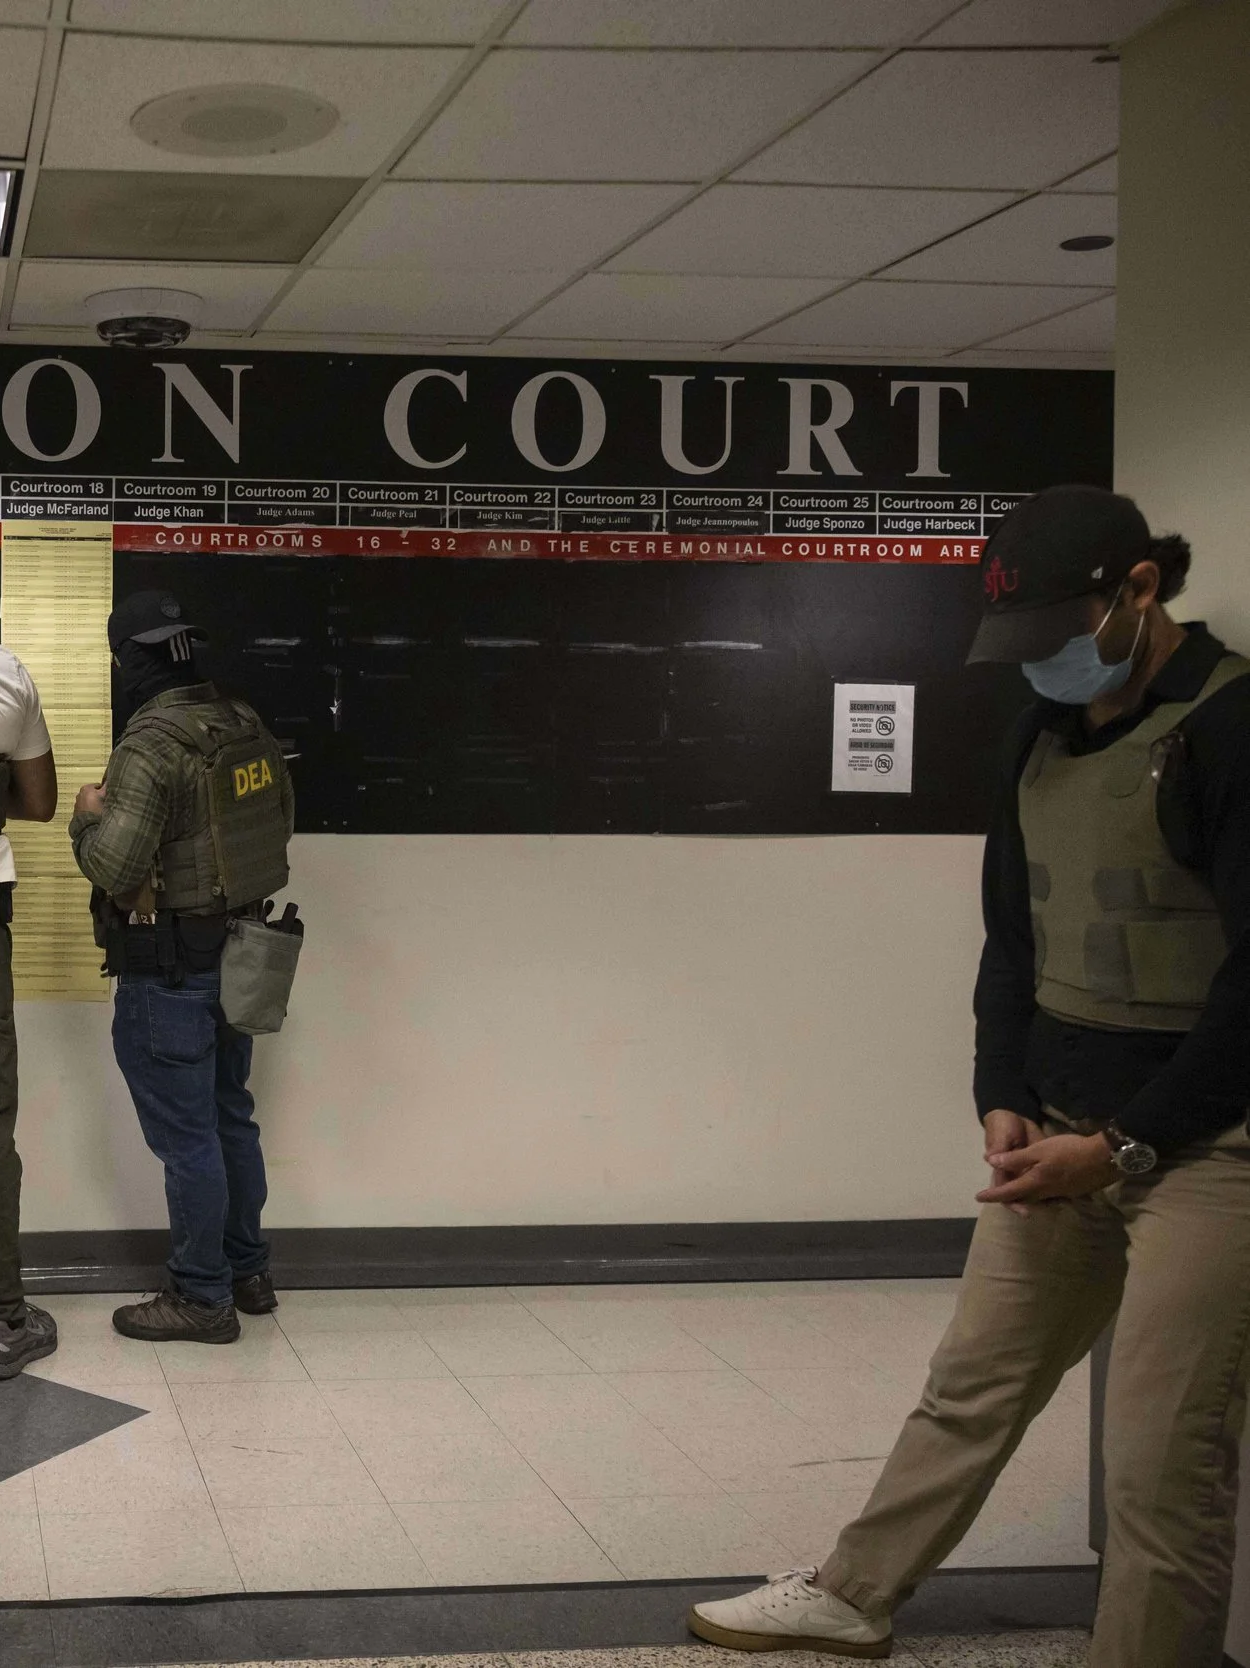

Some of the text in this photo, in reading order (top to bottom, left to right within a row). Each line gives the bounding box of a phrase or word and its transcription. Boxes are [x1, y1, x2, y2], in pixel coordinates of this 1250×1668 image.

[383, 368, 969, 477] COURT
[10, 481, 104, 496] Courtroom 18
[124, 483, 216, 496] Courtroom 19
[235, 485, 329, 498] Courtroom 20
[348, 488, 438, 500] Courtroom 21
[454, 490, 551, 503] Courtroom 22
[566, 493, 656, 505] Courtroom 23
[673, 494, 763, 506] Courtroom 24
[780, 496, 869, 508] Courtroom 25
[7, 503, 108, 516] Judge McFarland
[883, 497, 954, 509] Courtroom
[960, 499, 977, 510] 26
[134, 506, 203, 519] Judge Khan
[257, 508, 314, 517] Judge Adams
[371, 509, 416, 519] Judge Peal
[477, 512, 502, 520] Judge
[581, 516, 606, 525] Judge
[676, 517, 701, 526] Judge
[786, 517, 864, 530] Judge Sponzo
[884, 518, 975, 531] Judge Harbeck
[155, 532, 322, 547] COURTROOMS
[357, 537, 380, 549] 16
[431, 538, 456, 551] 32
[488, 539, 531, 552] AND
[548, 540, 589, 552] THE
[610, 541, 766, 555] CEREMONIAL
[781, 543, 922, 557] COURTROOM
[940, 545, 980, 558] ARE
[850, 703, 875, 711] SECURITY
[234, 758, 273, 797] DEA
